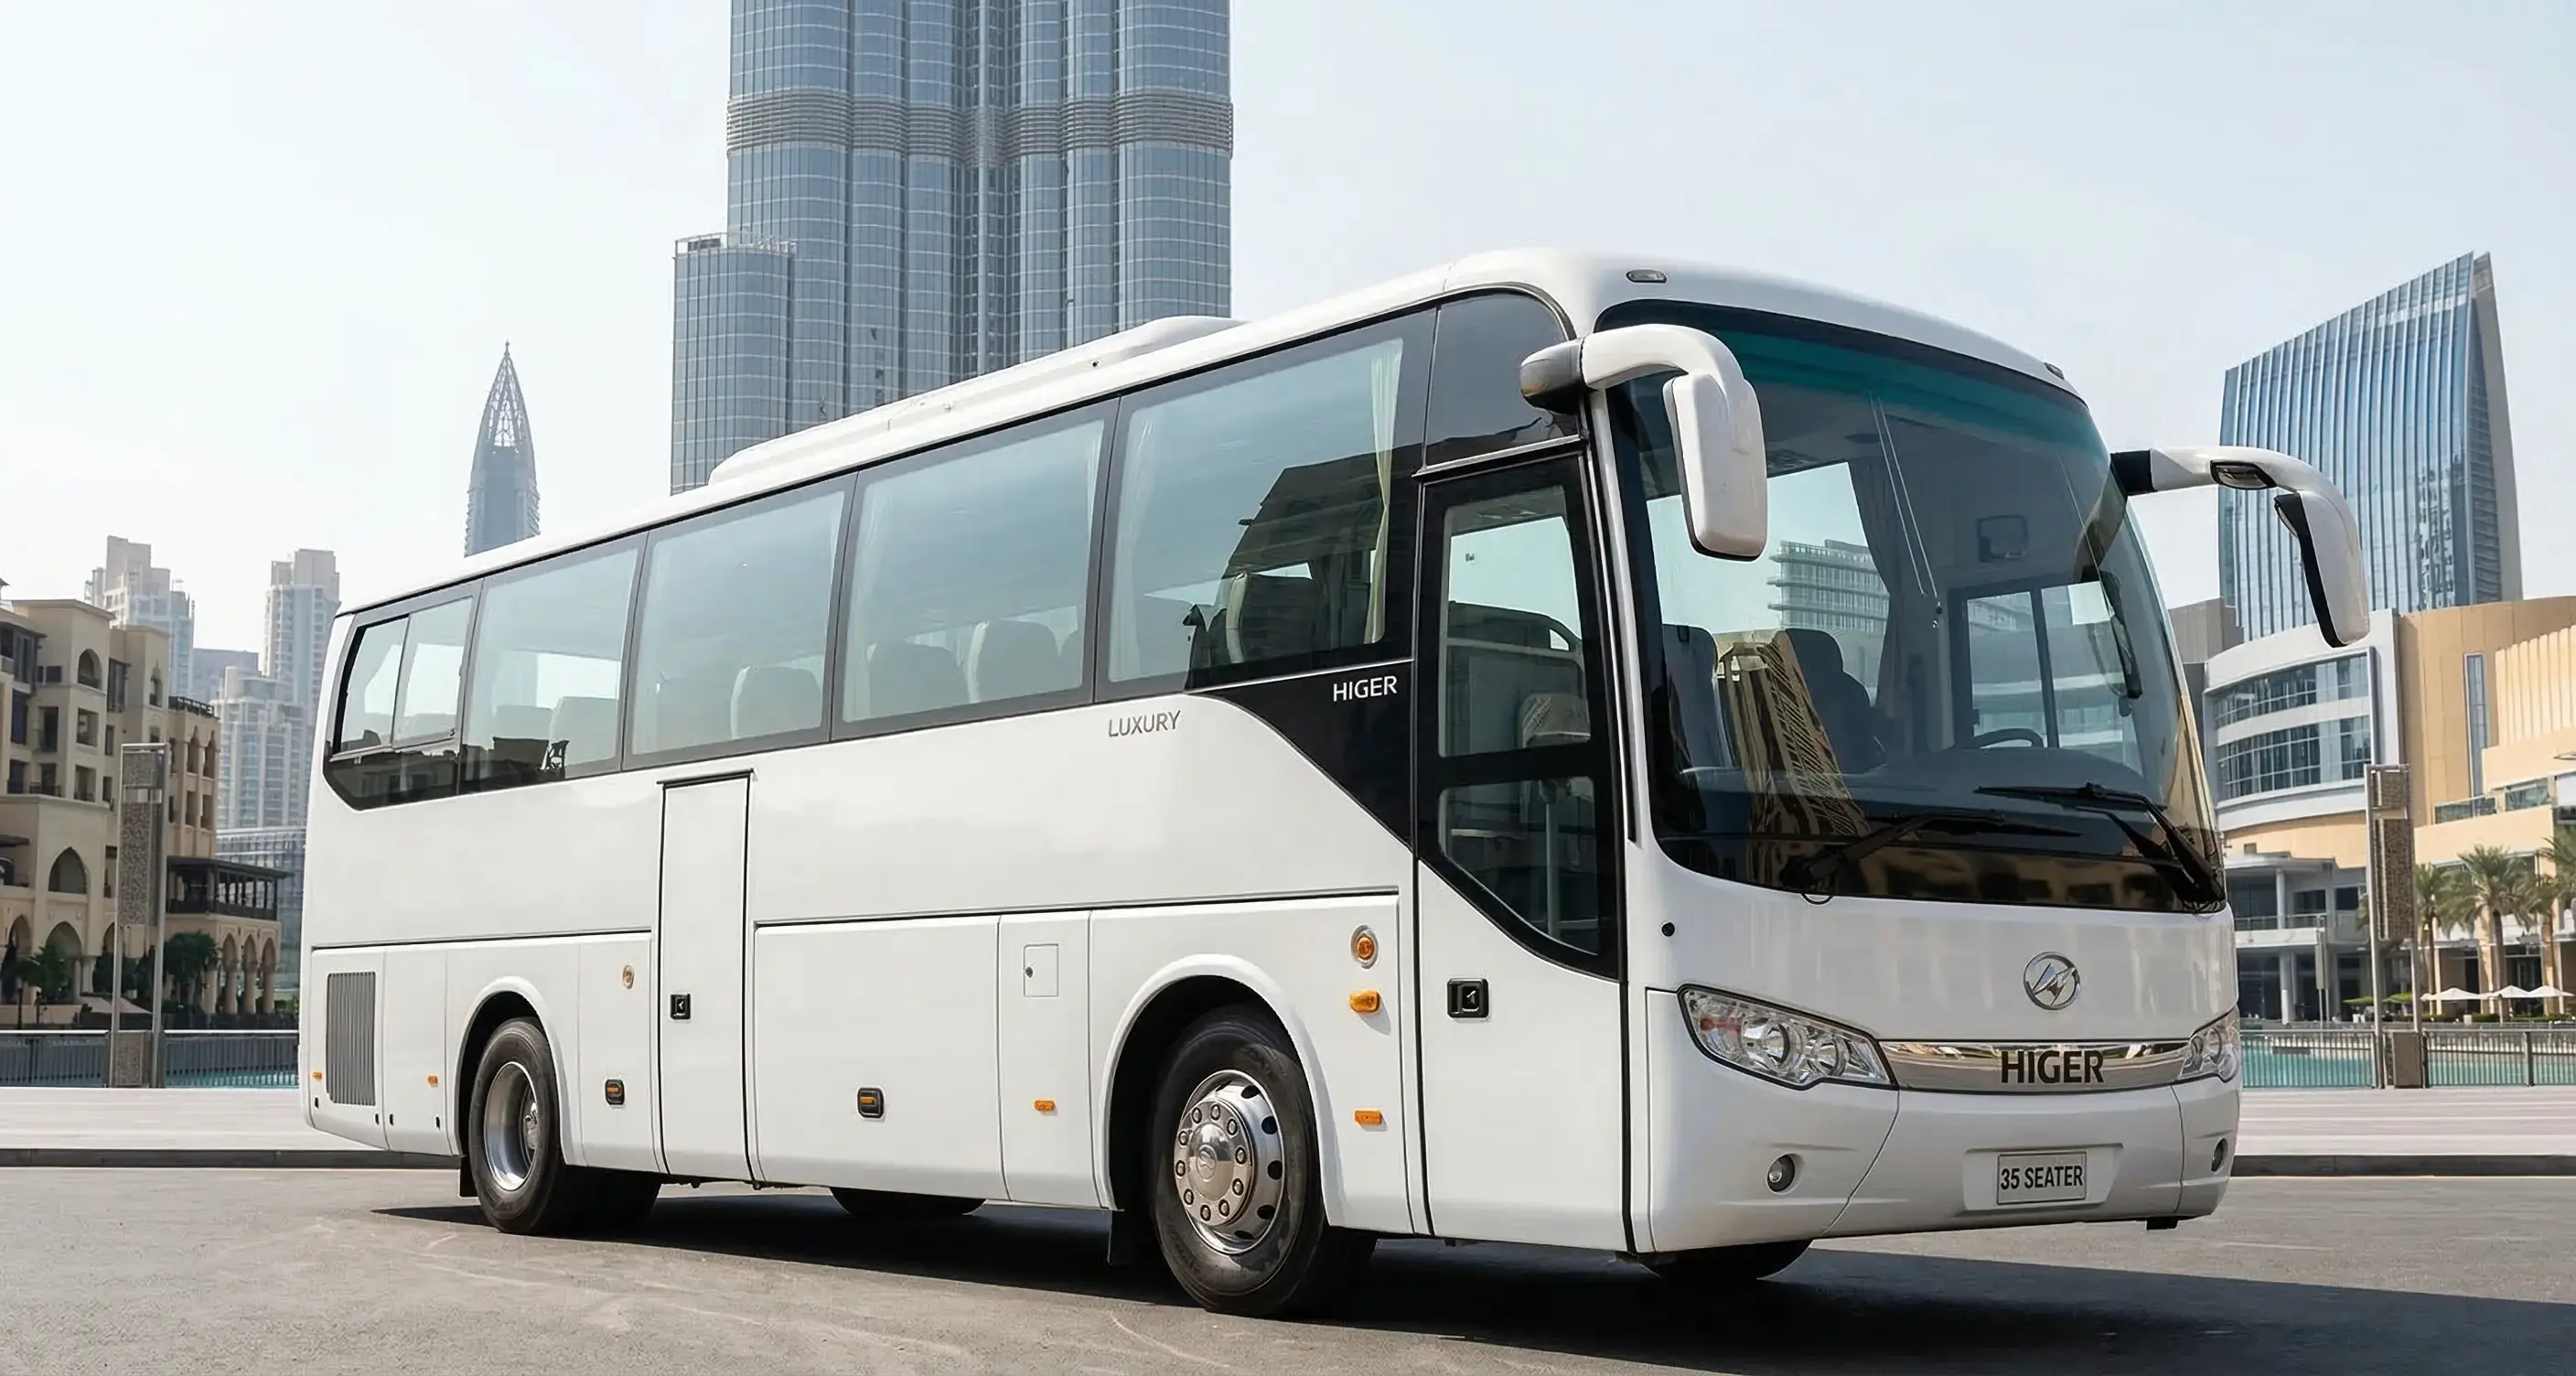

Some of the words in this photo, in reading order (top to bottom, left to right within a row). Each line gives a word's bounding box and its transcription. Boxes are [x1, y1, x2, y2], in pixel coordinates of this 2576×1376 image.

[1333, 675, 1398, 702] HIGER
[1108, 710, 1181, 737] LUXURY
[2001, 1050, 2104, 1084] HIGER
[2000, 1167, 2020, 1190] 35
[2024, 1165, 2083, 1189] SEATER
